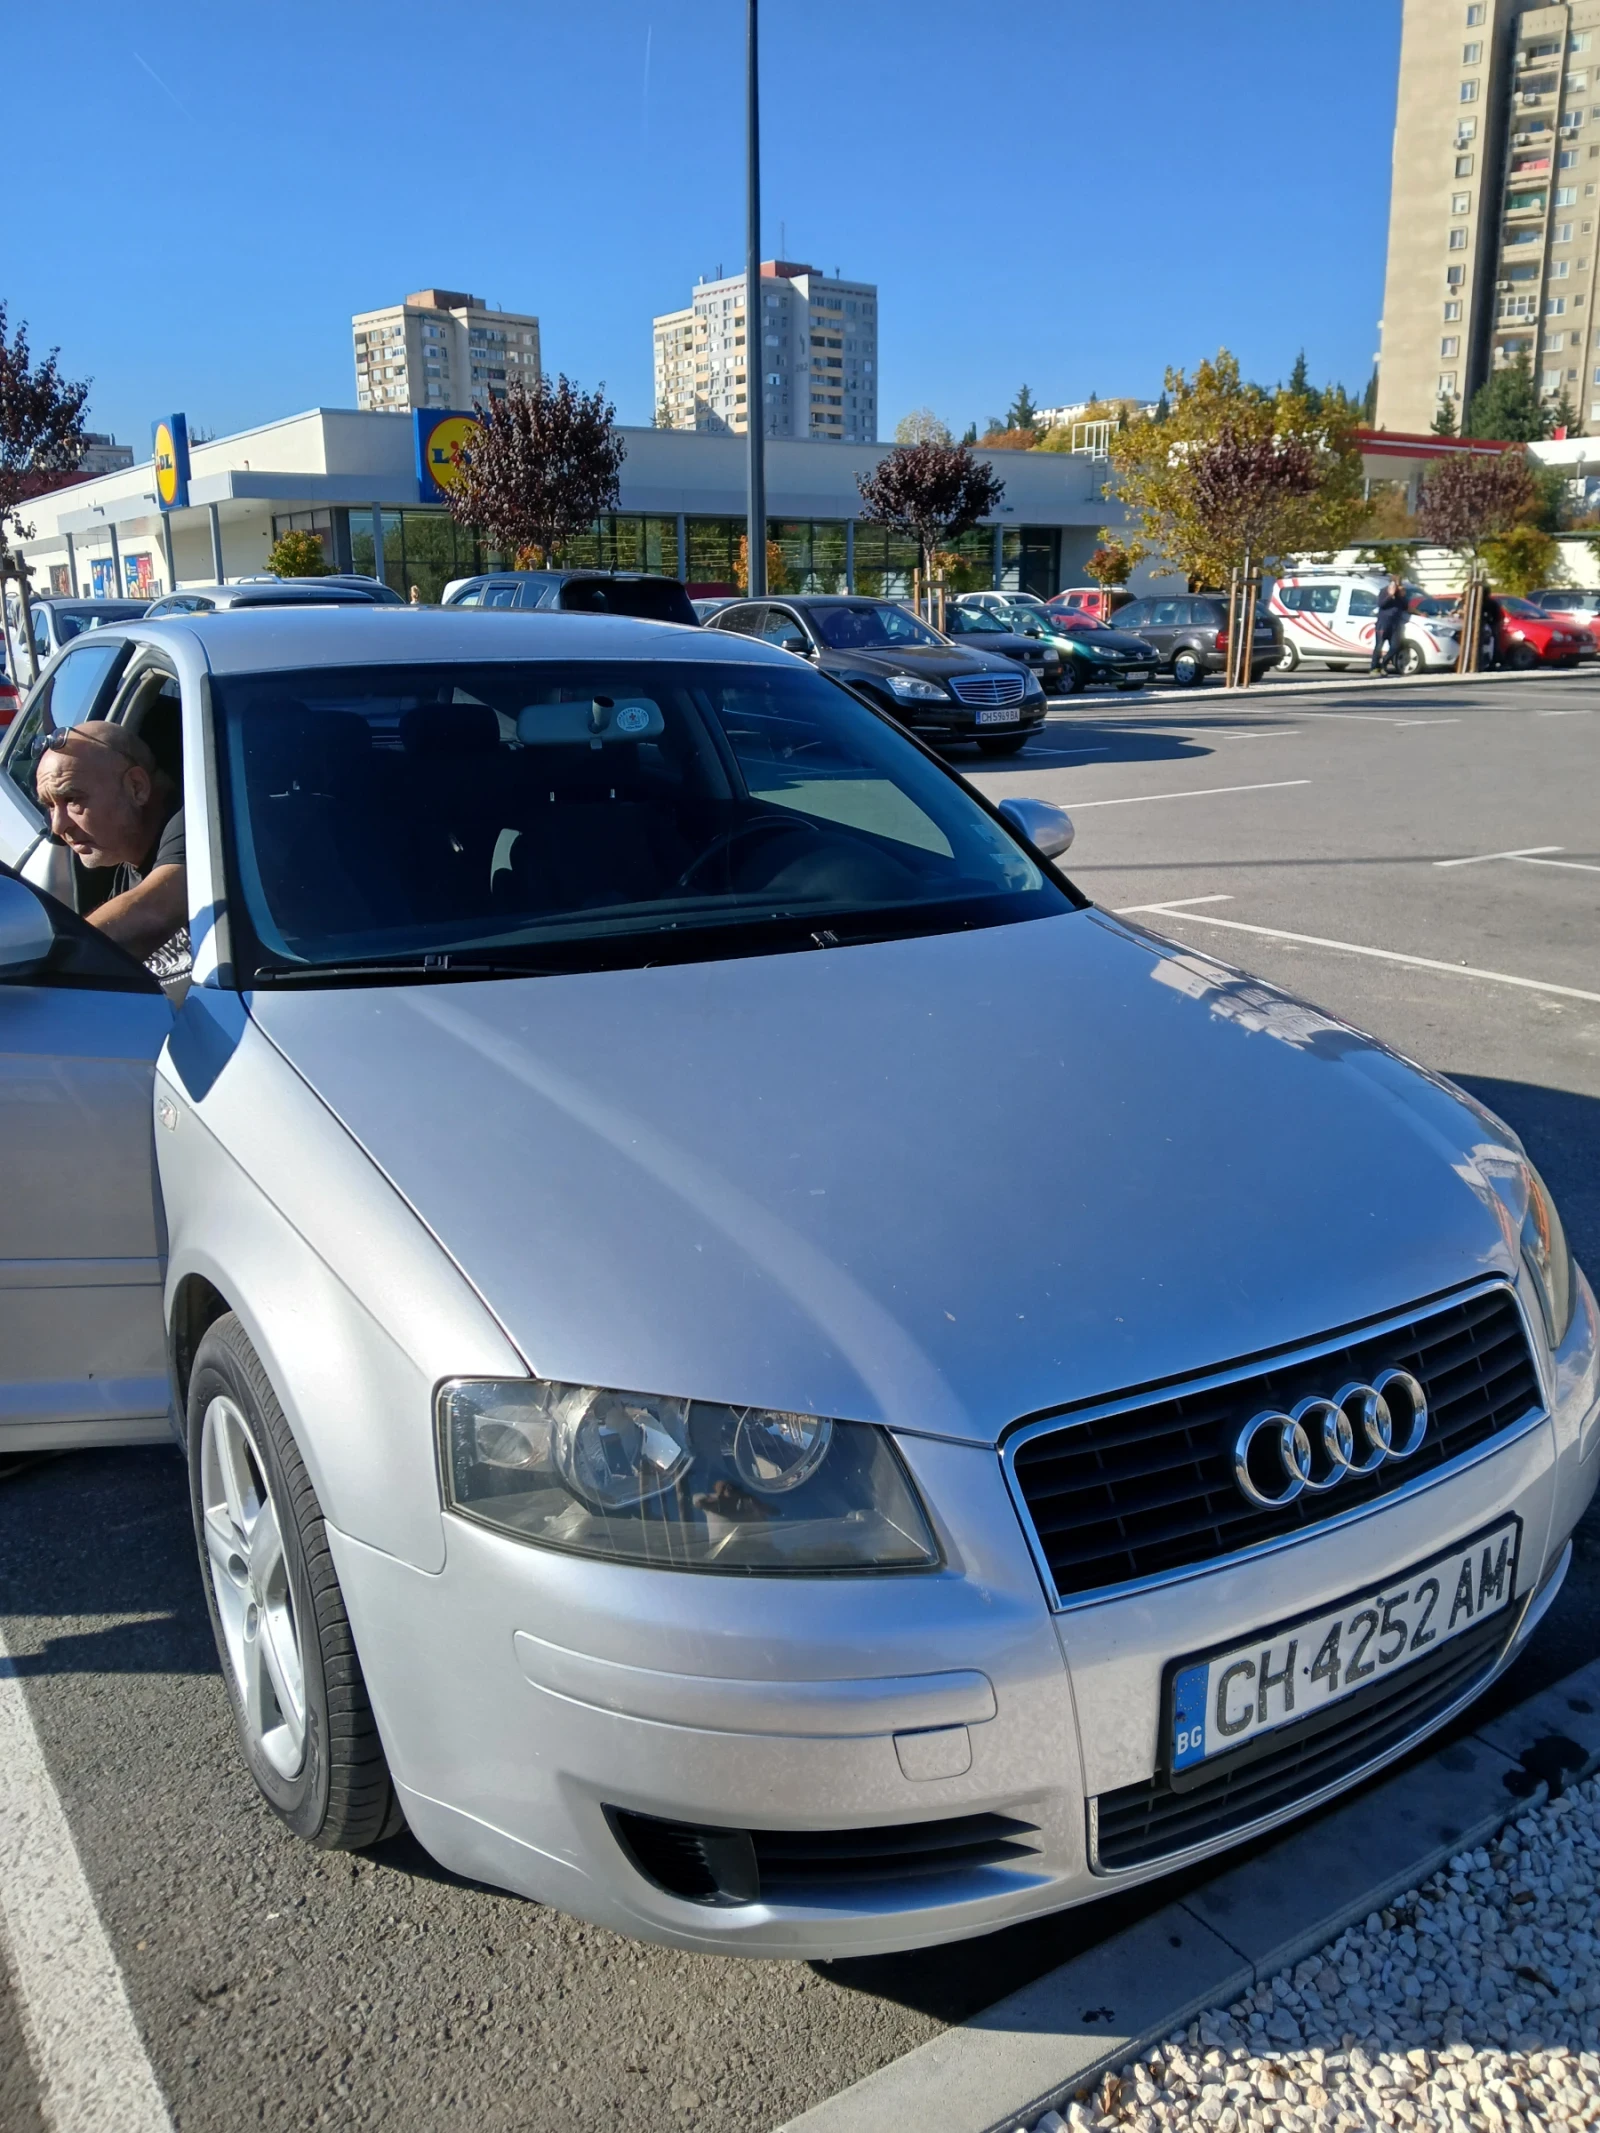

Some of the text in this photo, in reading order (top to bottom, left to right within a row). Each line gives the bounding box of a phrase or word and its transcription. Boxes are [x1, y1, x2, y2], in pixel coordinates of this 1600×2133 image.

[1217, 1537, 1510, 1736] CH 4252 AM
[1176, 1726, 1203, 1755] BG
